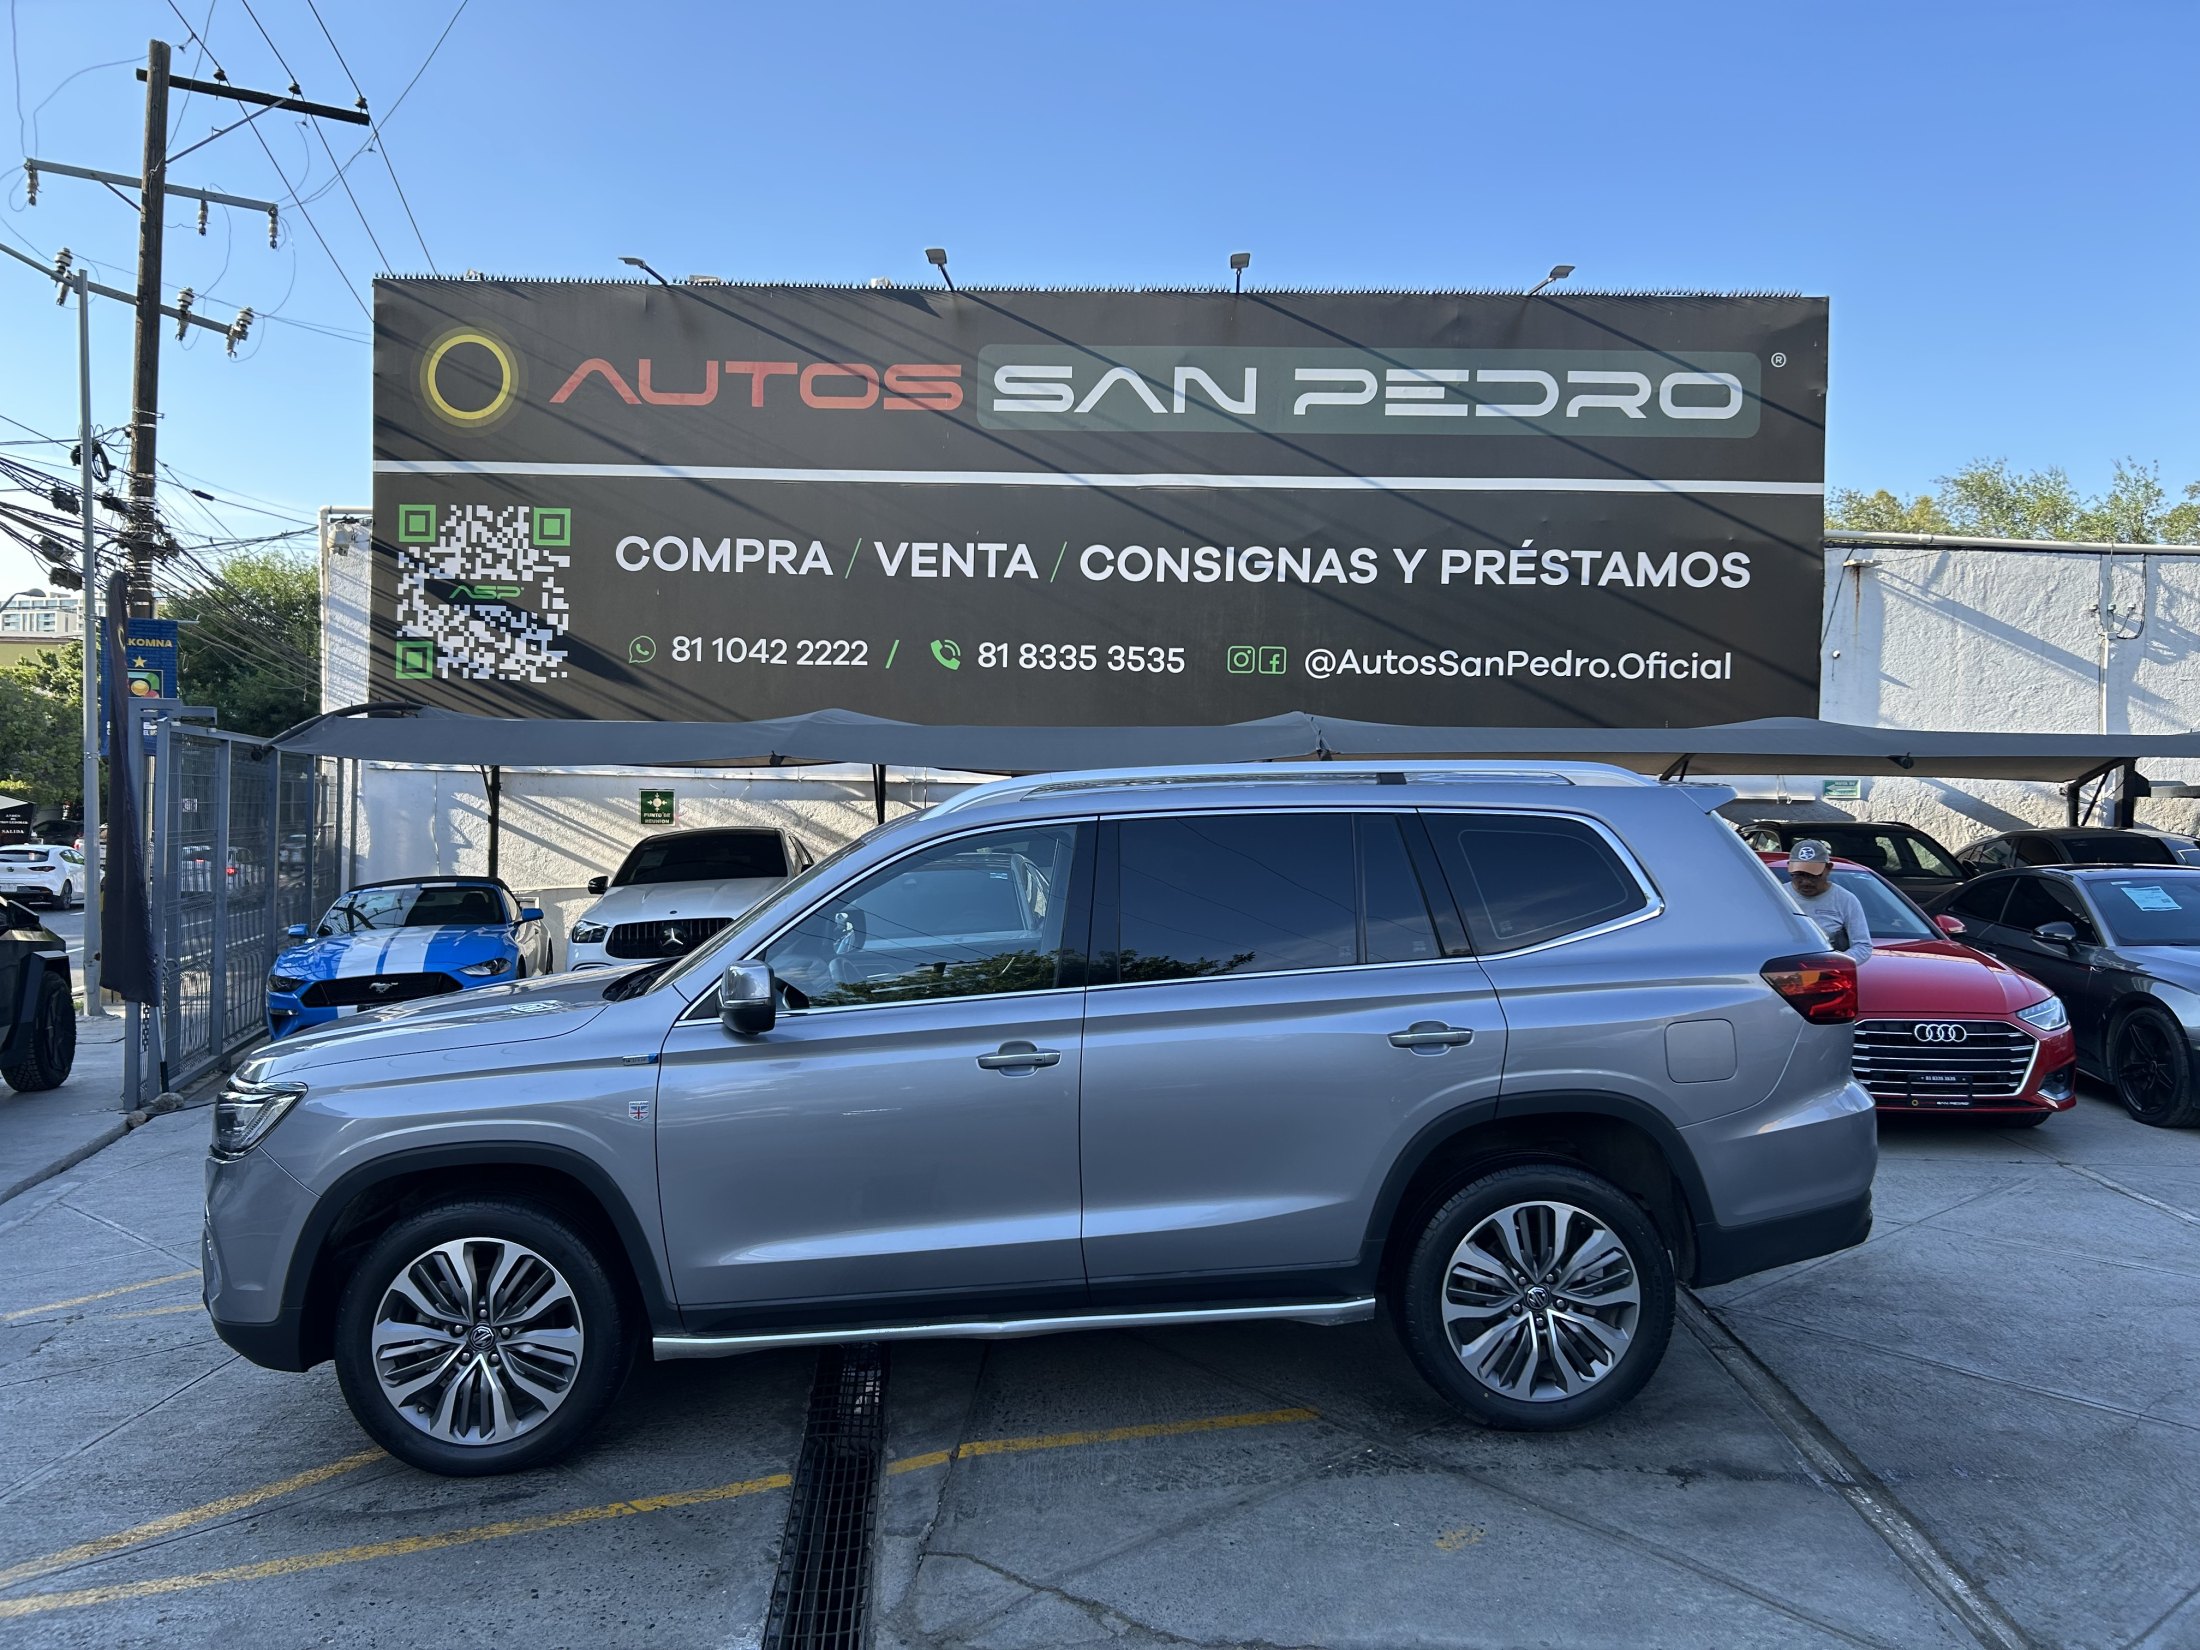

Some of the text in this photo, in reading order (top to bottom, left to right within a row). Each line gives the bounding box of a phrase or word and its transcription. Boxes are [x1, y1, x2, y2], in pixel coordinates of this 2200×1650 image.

[550, 357, 964, 411] AUTOS
[993, 364, 1257, 415] SAN
[1293, 367, 1744, 420] PEDRO
[615, 535, 834, 577] COMPRA
[873, 541, 1040, 581] VENTA
[1078, 543, 1379, 585] CONSIGNAS
[1392, 547, 1428, 584] Y
[1440, 538, 1752, 590] PRÉSTAMOS
[127, 638, 173, 648] KOMNA
[671, 636, 703, 662] 81
[711, 636, 788, 665] 1042
[796, 640, 869, 667] 2222
[977, 641, 1187, 674] 81 8335 3535
[1304, 648, 1733, 681] @AutosSanPedro.Oficial
